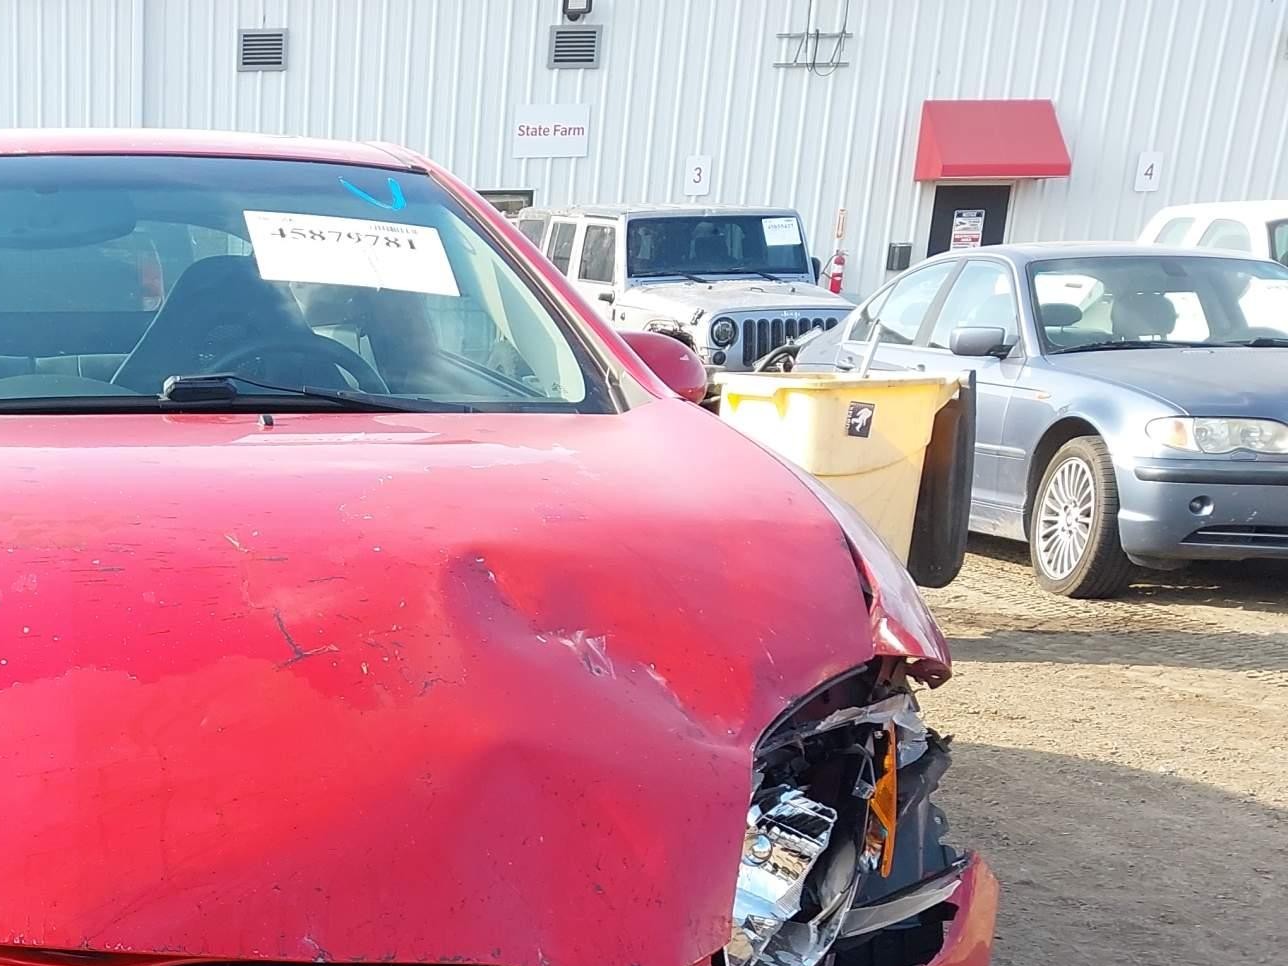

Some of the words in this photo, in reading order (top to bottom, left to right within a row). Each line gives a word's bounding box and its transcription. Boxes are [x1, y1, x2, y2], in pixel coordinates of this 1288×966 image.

[518, 124, 550, 137] State
[553, 124, 585, 137] Farm
[692, 167, 703, 184] 3
[1143, 162, 1156, 181] 4
